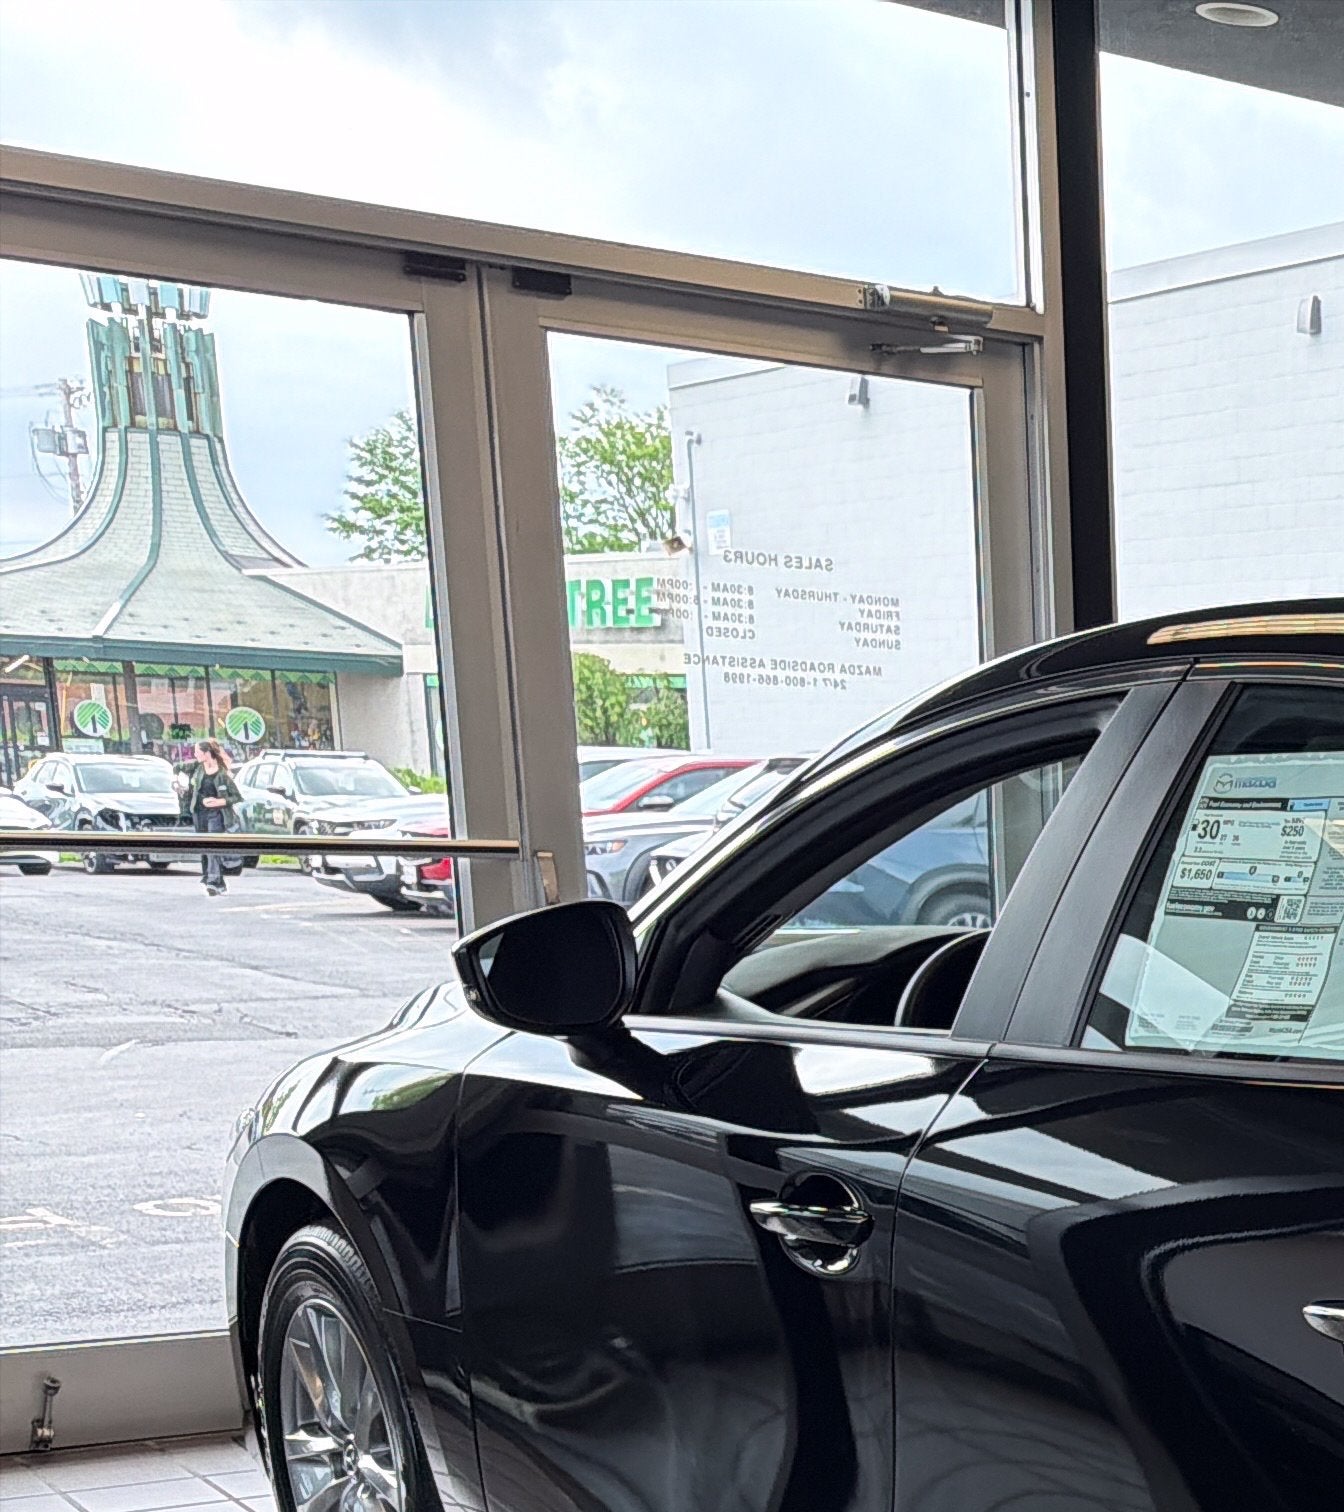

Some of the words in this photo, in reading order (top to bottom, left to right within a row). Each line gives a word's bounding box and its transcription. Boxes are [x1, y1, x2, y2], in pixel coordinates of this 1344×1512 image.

[567, 577, 660, 628] TREE
[1197, 819, 1221, 840] 30
[1280, 825, 1305, 837] $250
[1179, 867, 1213, 881] $1,650
